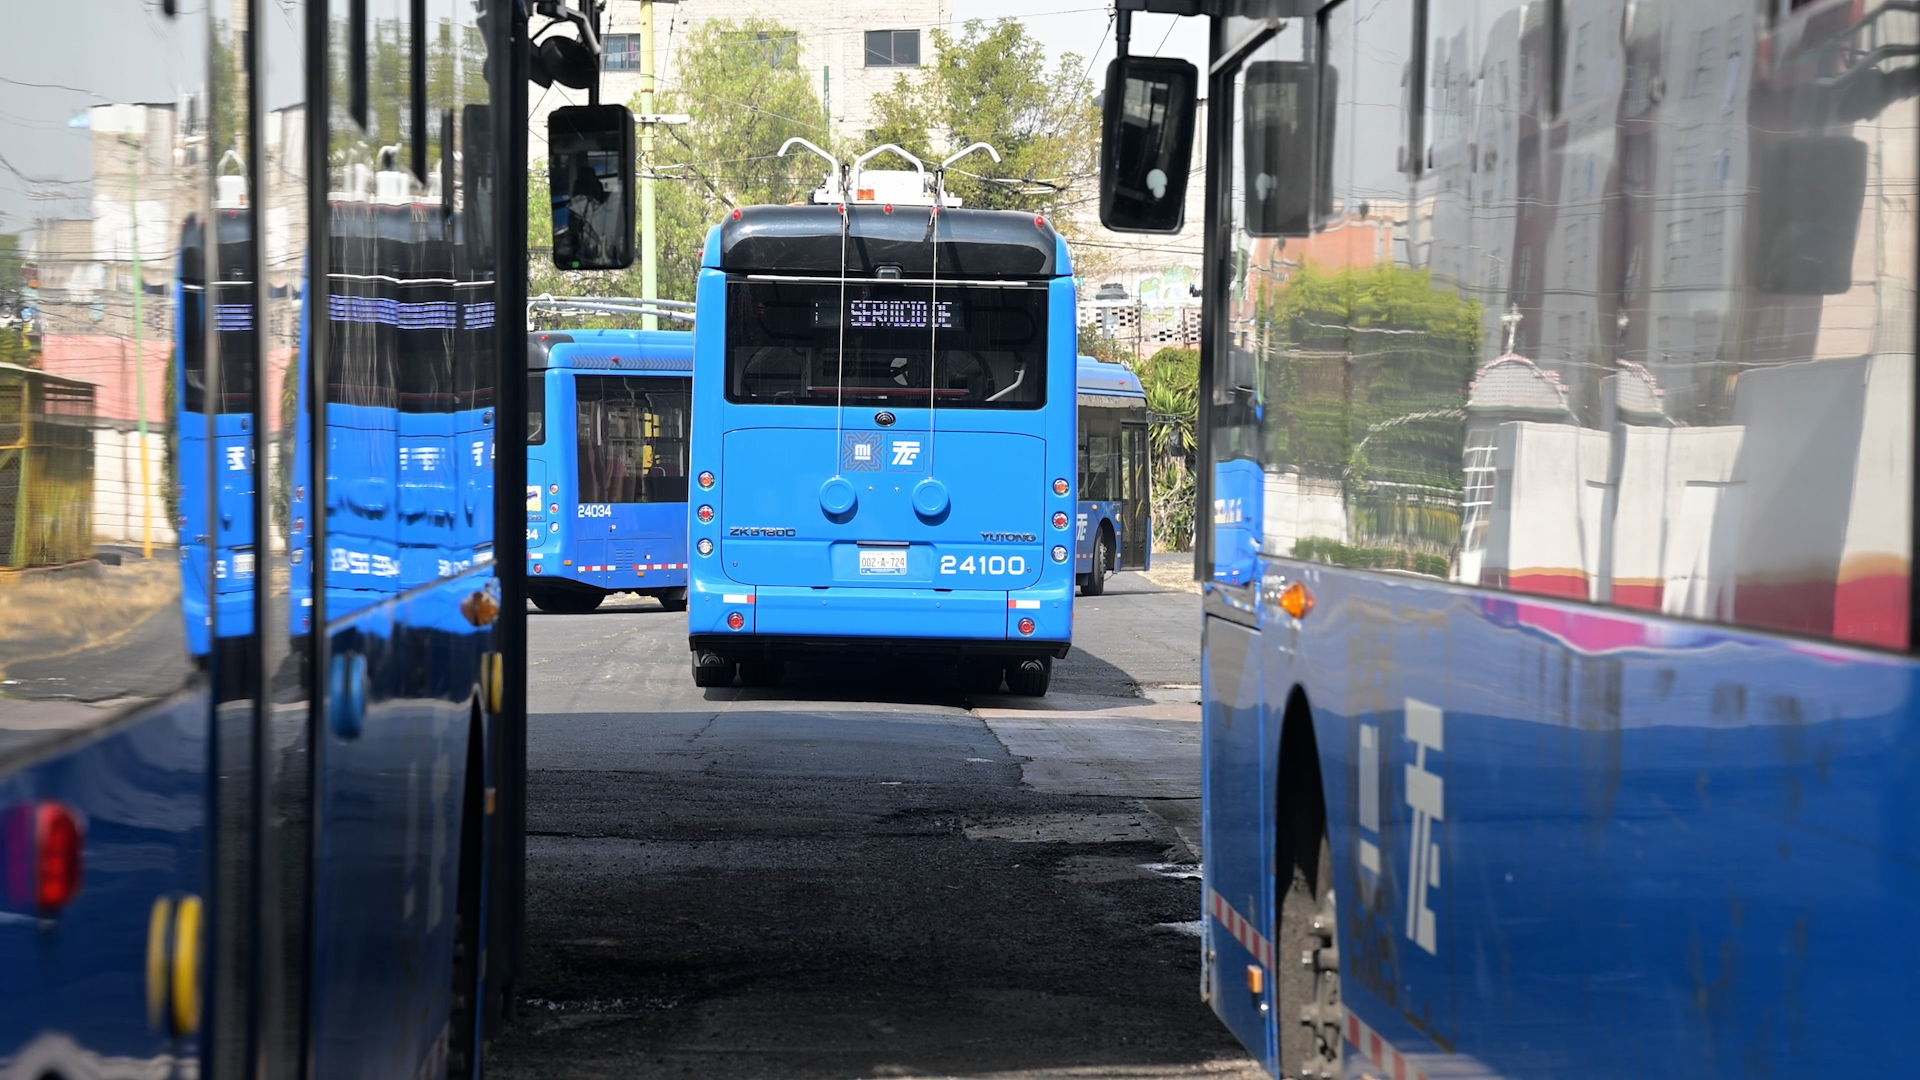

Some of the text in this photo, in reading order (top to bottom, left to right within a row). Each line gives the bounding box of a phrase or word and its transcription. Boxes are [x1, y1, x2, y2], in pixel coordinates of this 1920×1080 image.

[851, 300, 926, 327] SERVICIO
[577, 504, 611, 518] 24034
[980, 531, 1036, 542] YUTONG
[861, 557, 905, 568] 002-A-724
[940, 555, 1025, 575] 24100
